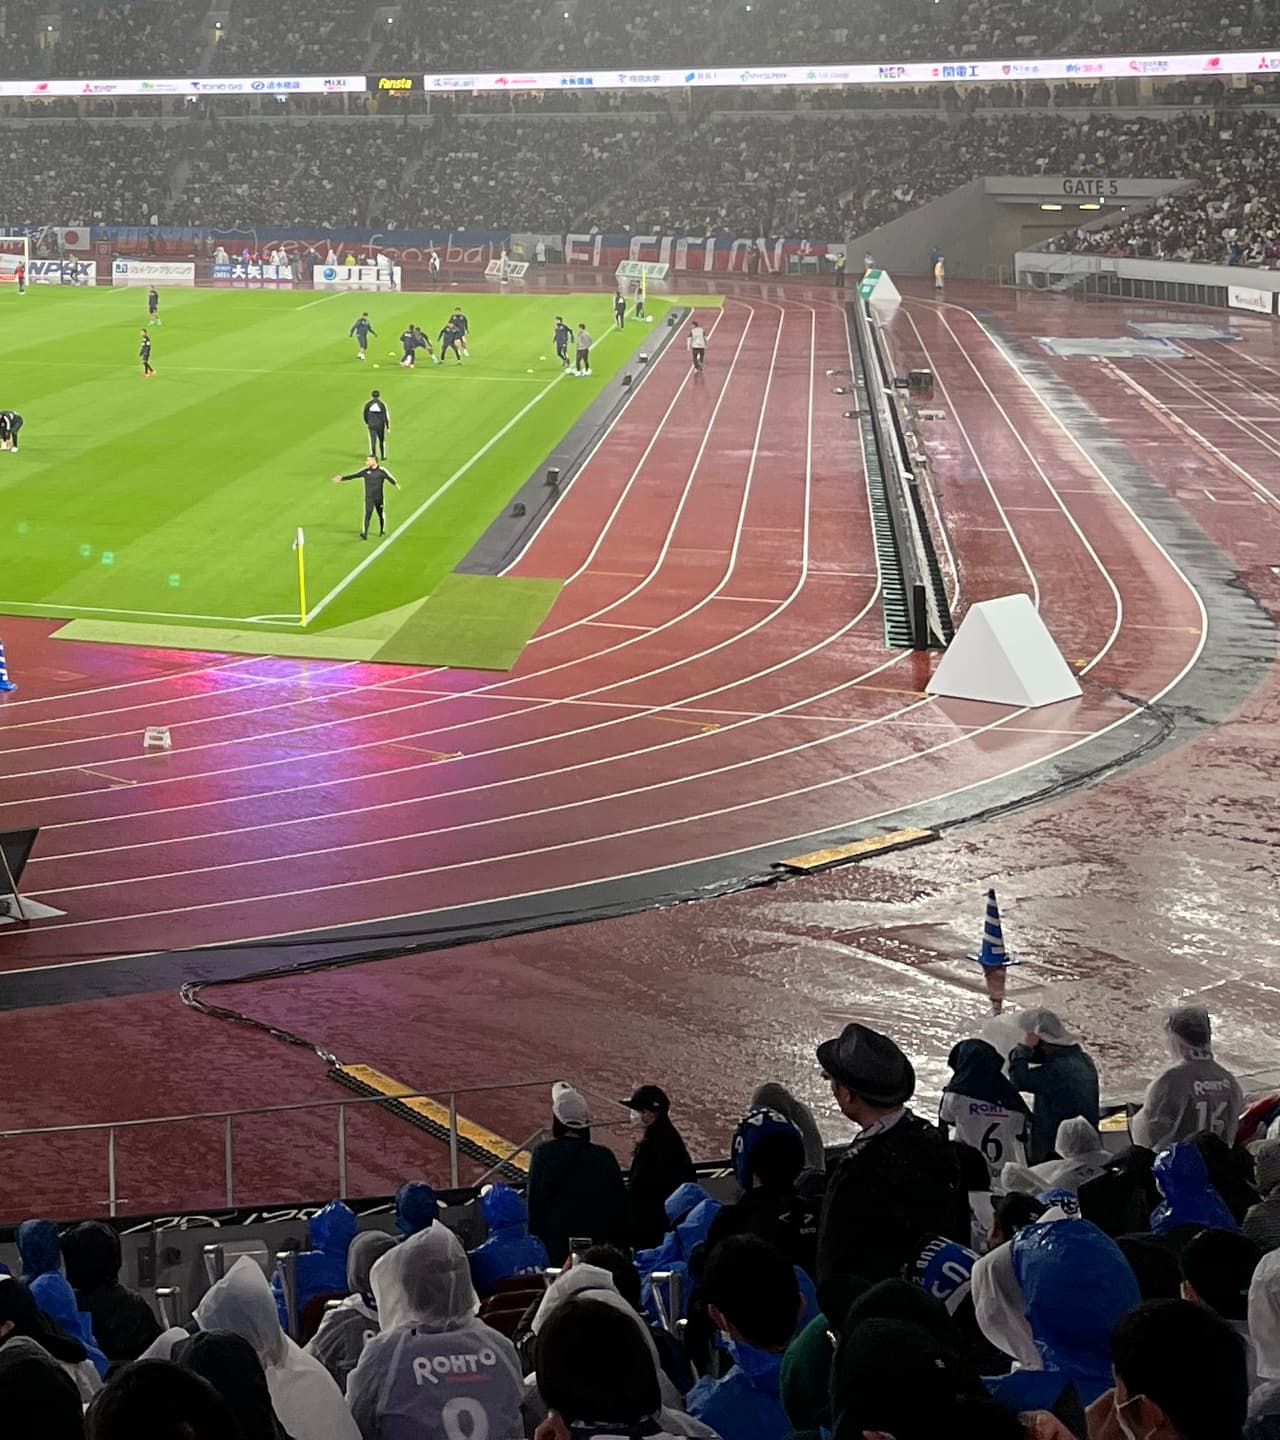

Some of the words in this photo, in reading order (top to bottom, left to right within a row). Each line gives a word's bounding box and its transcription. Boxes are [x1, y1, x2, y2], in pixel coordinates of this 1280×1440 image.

[943, 65, 979, 78] 関電工
[1063, 180, 1104, 194] GATE
[1110, 180, 1118, 194] 5
[969, 1103, 1006, 1115] ROHT
[981, 1122, 1002, 1162] 6
[412, 1348, 496, 1386] ROHTO
